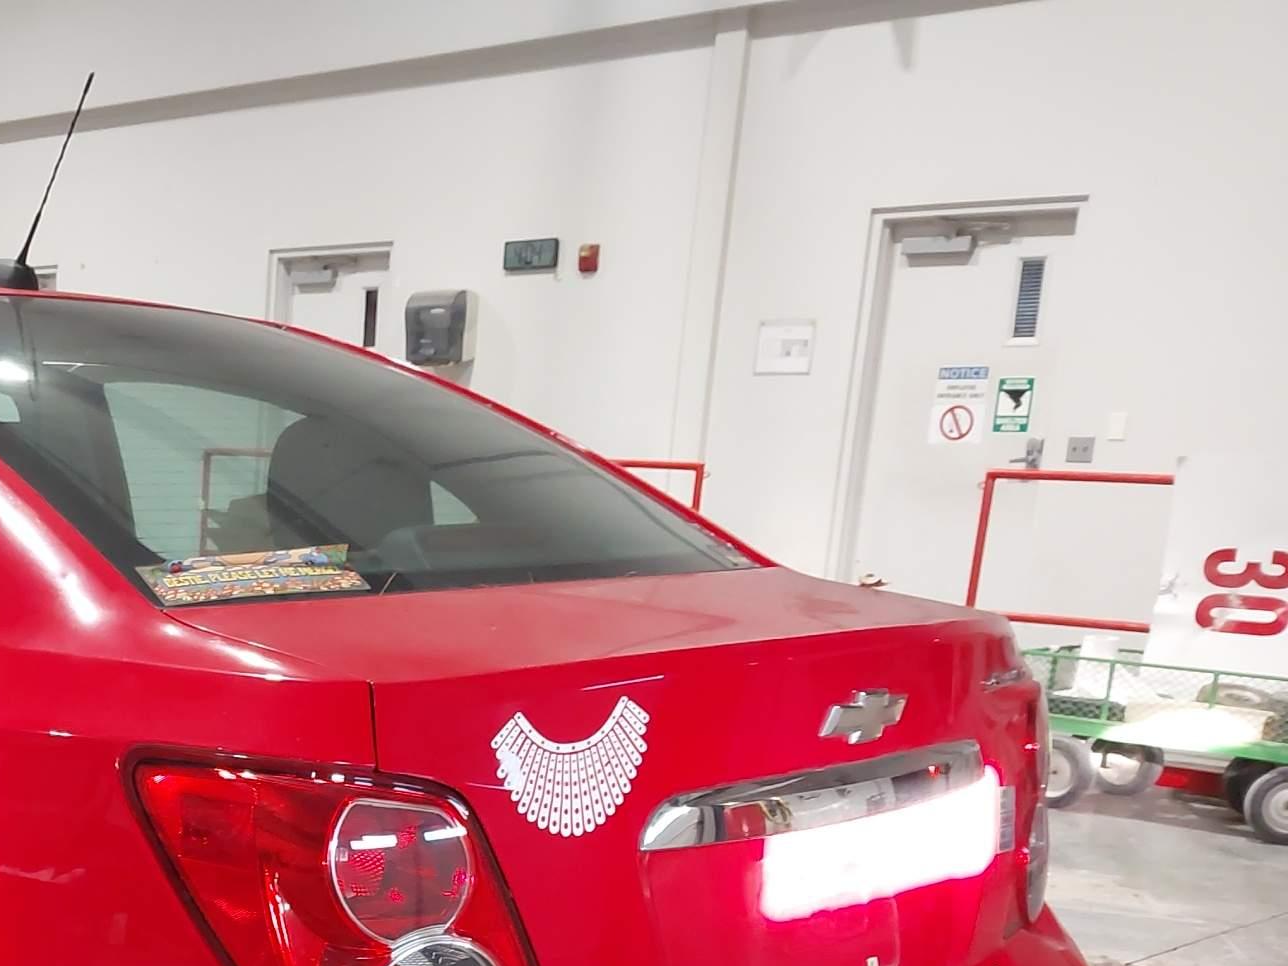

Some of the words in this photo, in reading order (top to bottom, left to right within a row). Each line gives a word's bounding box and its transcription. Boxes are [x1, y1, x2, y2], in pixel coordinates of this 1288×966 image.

[940, 367, 989, 379] NOTICE
[208, 570, 258, 583] PLEASE
[255, 567, 280, 580] LET
